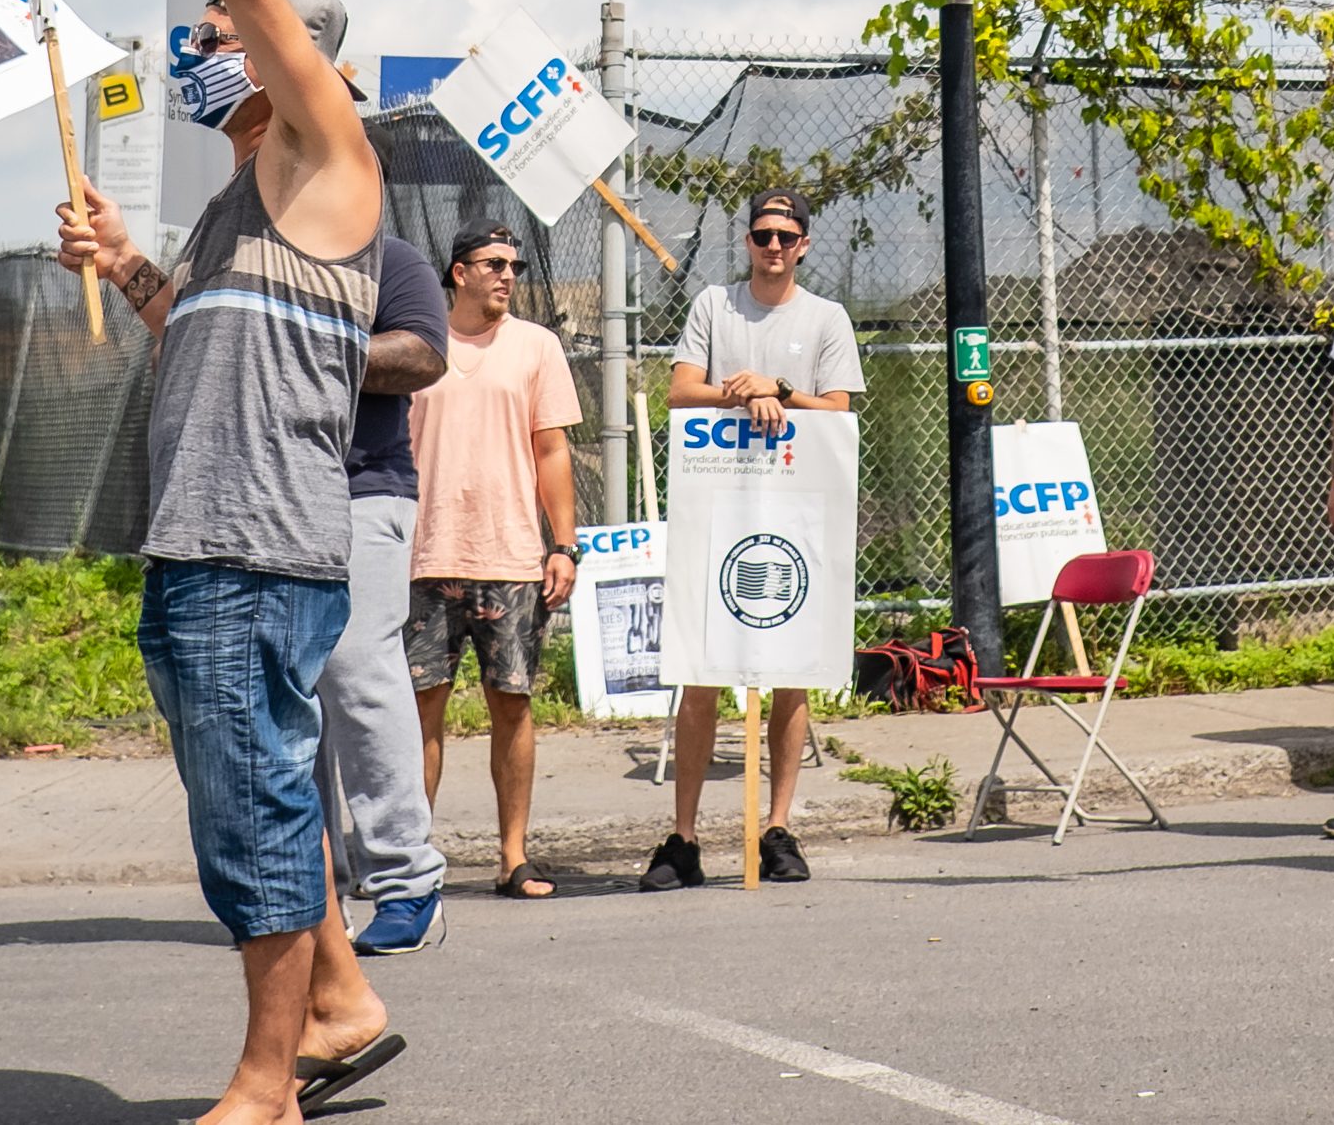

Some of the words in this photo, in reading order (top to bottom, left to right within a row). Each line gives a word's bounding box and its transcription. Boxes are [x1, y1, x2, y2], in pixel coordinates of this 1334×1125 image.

[102, 83, 129, 106] B
[477, 58, 567, 161] SCFP
[514, 139, 548, 172] fonction
[683, 418, 796, 450] SCFP
[682, 454, 720, 465] Syndicat
[722, 455, 764, 464] canadien
[765, 455, 777, 465] de
[682, 465, 691, 473] la
[693, 465, 732, 474] fonction
[733, 465, 774, 476] publique
[995, 481, 1089, 517] SCFP
[578, 528, 651, 555] SCFP
